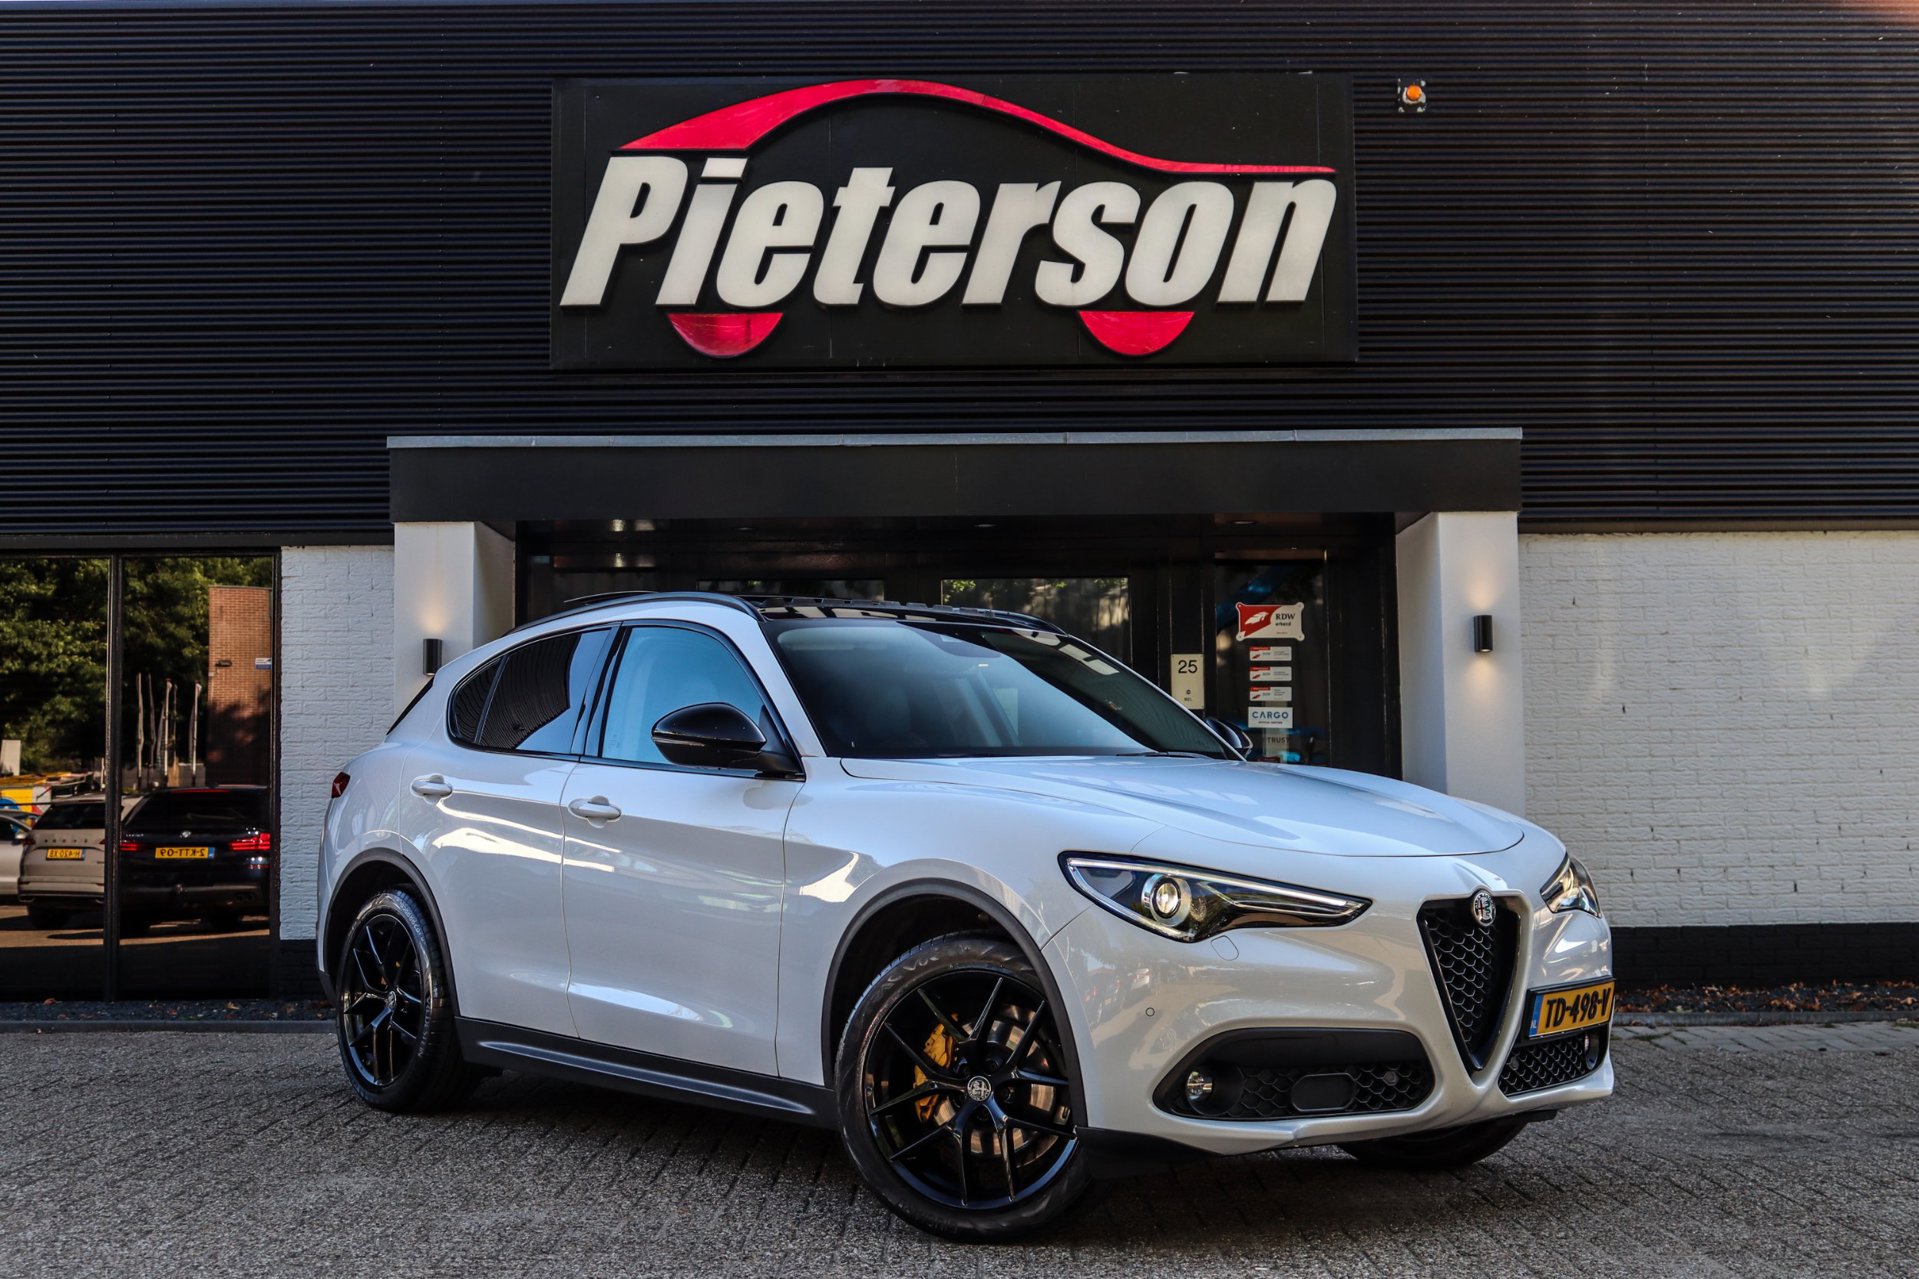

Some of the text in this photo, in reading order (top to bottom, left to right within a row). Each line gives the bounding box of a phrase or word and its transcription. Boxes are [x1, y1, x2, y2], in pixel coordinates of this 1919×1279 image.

[558, 155, 1338, 309] Pieterson
[1178, 659, 1198, 674] 25
[1252, 711, 1289, 719] CARGO
[1545, 988, 1612, 1028] TD-498-V
